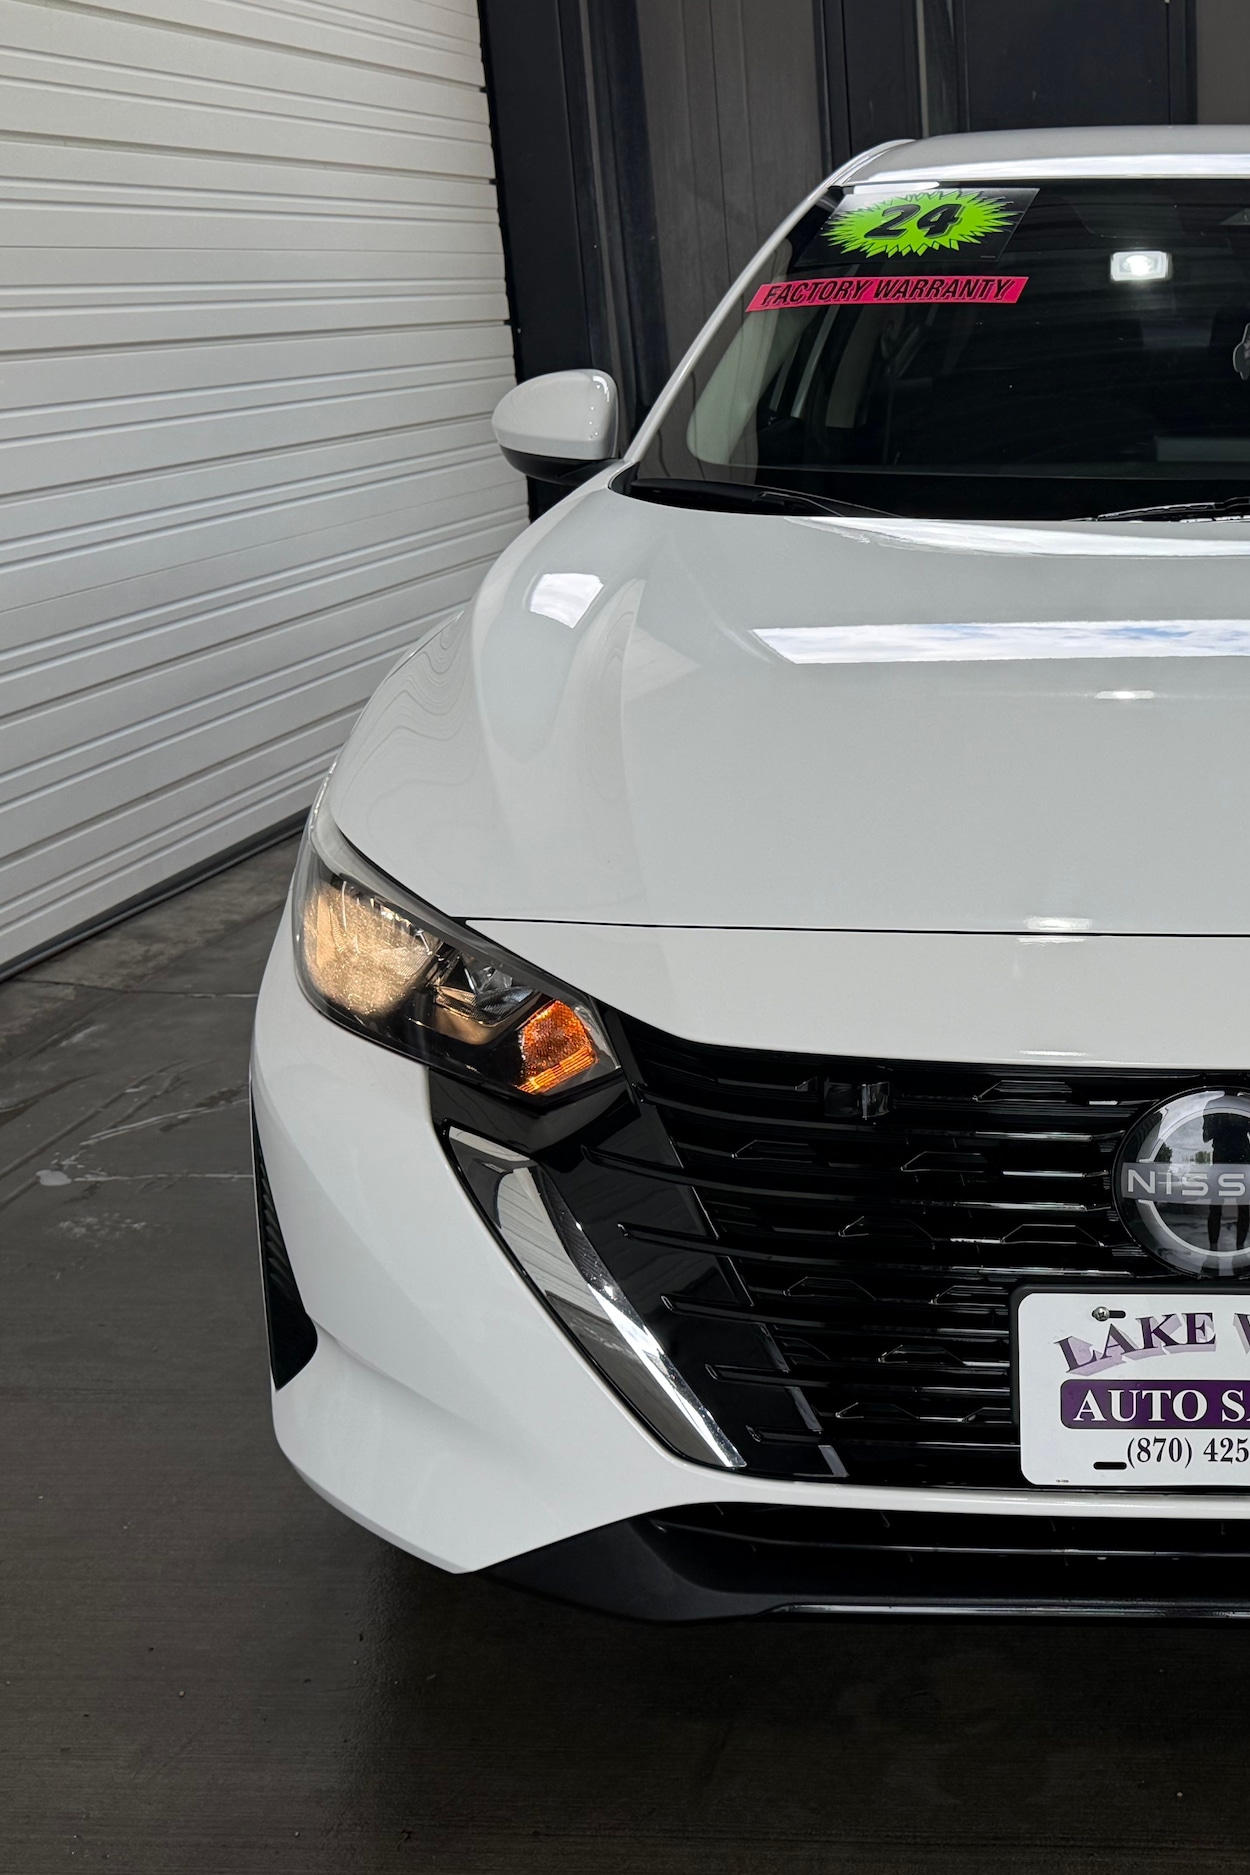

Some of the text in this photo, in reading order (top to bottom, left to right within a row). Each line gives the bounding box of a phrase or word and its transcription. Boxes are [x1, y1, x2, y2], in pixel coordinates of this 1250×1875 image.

[864, 203, 964, 240] 24
[761, 278, 1016, 306] FACTORY WARRANTY
[1053, 1312, 1217, 1376] LAKE
[1072, 1388, 1208, 1424] AUTO
[1126, 1436, 1193, 1469] (870)
